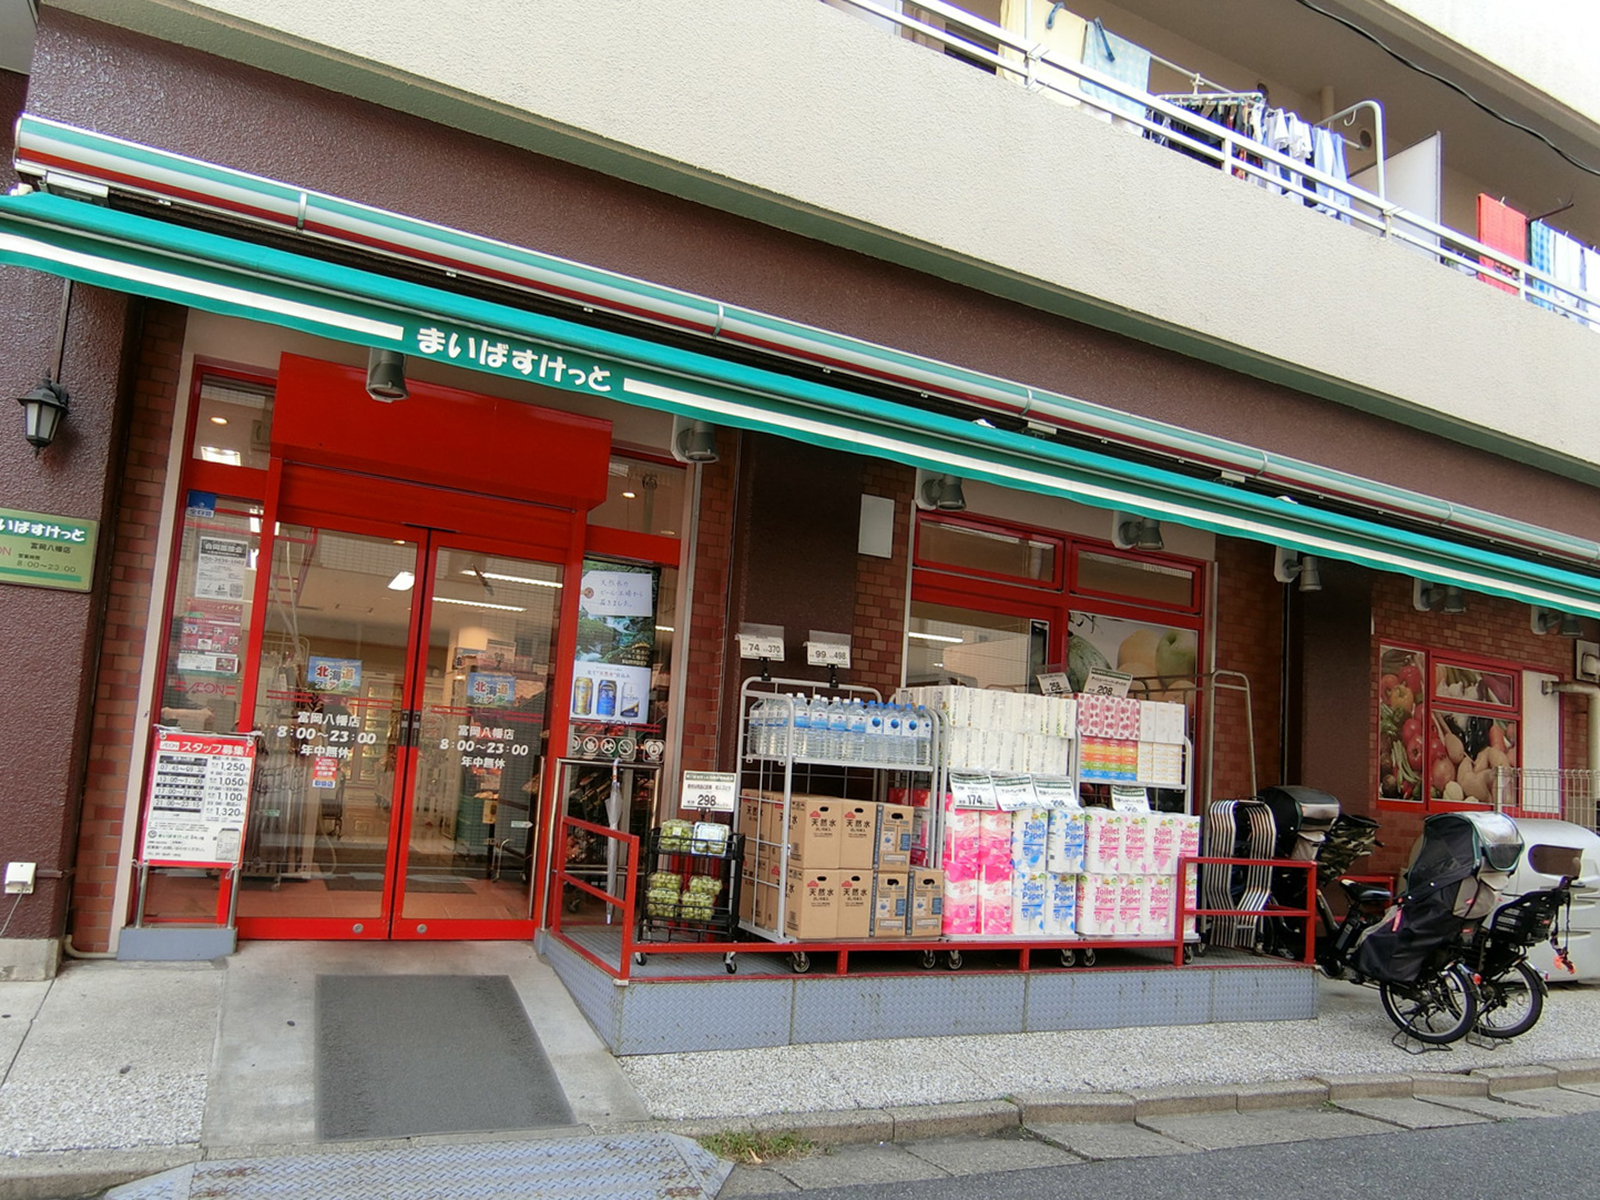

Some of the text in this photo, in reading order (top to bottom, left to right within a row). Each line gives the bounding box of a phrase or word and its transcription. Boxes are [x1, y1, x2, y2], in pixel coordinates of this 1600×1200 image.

[417, 327, 611, 392] まいばすけっと
[31, 542, 71, 554] 富岡八幡店
[815, 650, 826, 659] 99
[298, 711, 361, 728] 富岡八幡店
[458, 725, 515, 740] 富岡八幡店
[300, 744, 351, 758] 年中無休
[461, 756, 506, 769] 年中無休
[697, 794, 717, 807] 298
[811, 818, 836, 827] 天然水
[846, 819, 871, 828] 天然水
[809, 888, 834, 896] 天然水
[843, 888, 867, 896] 天然水
